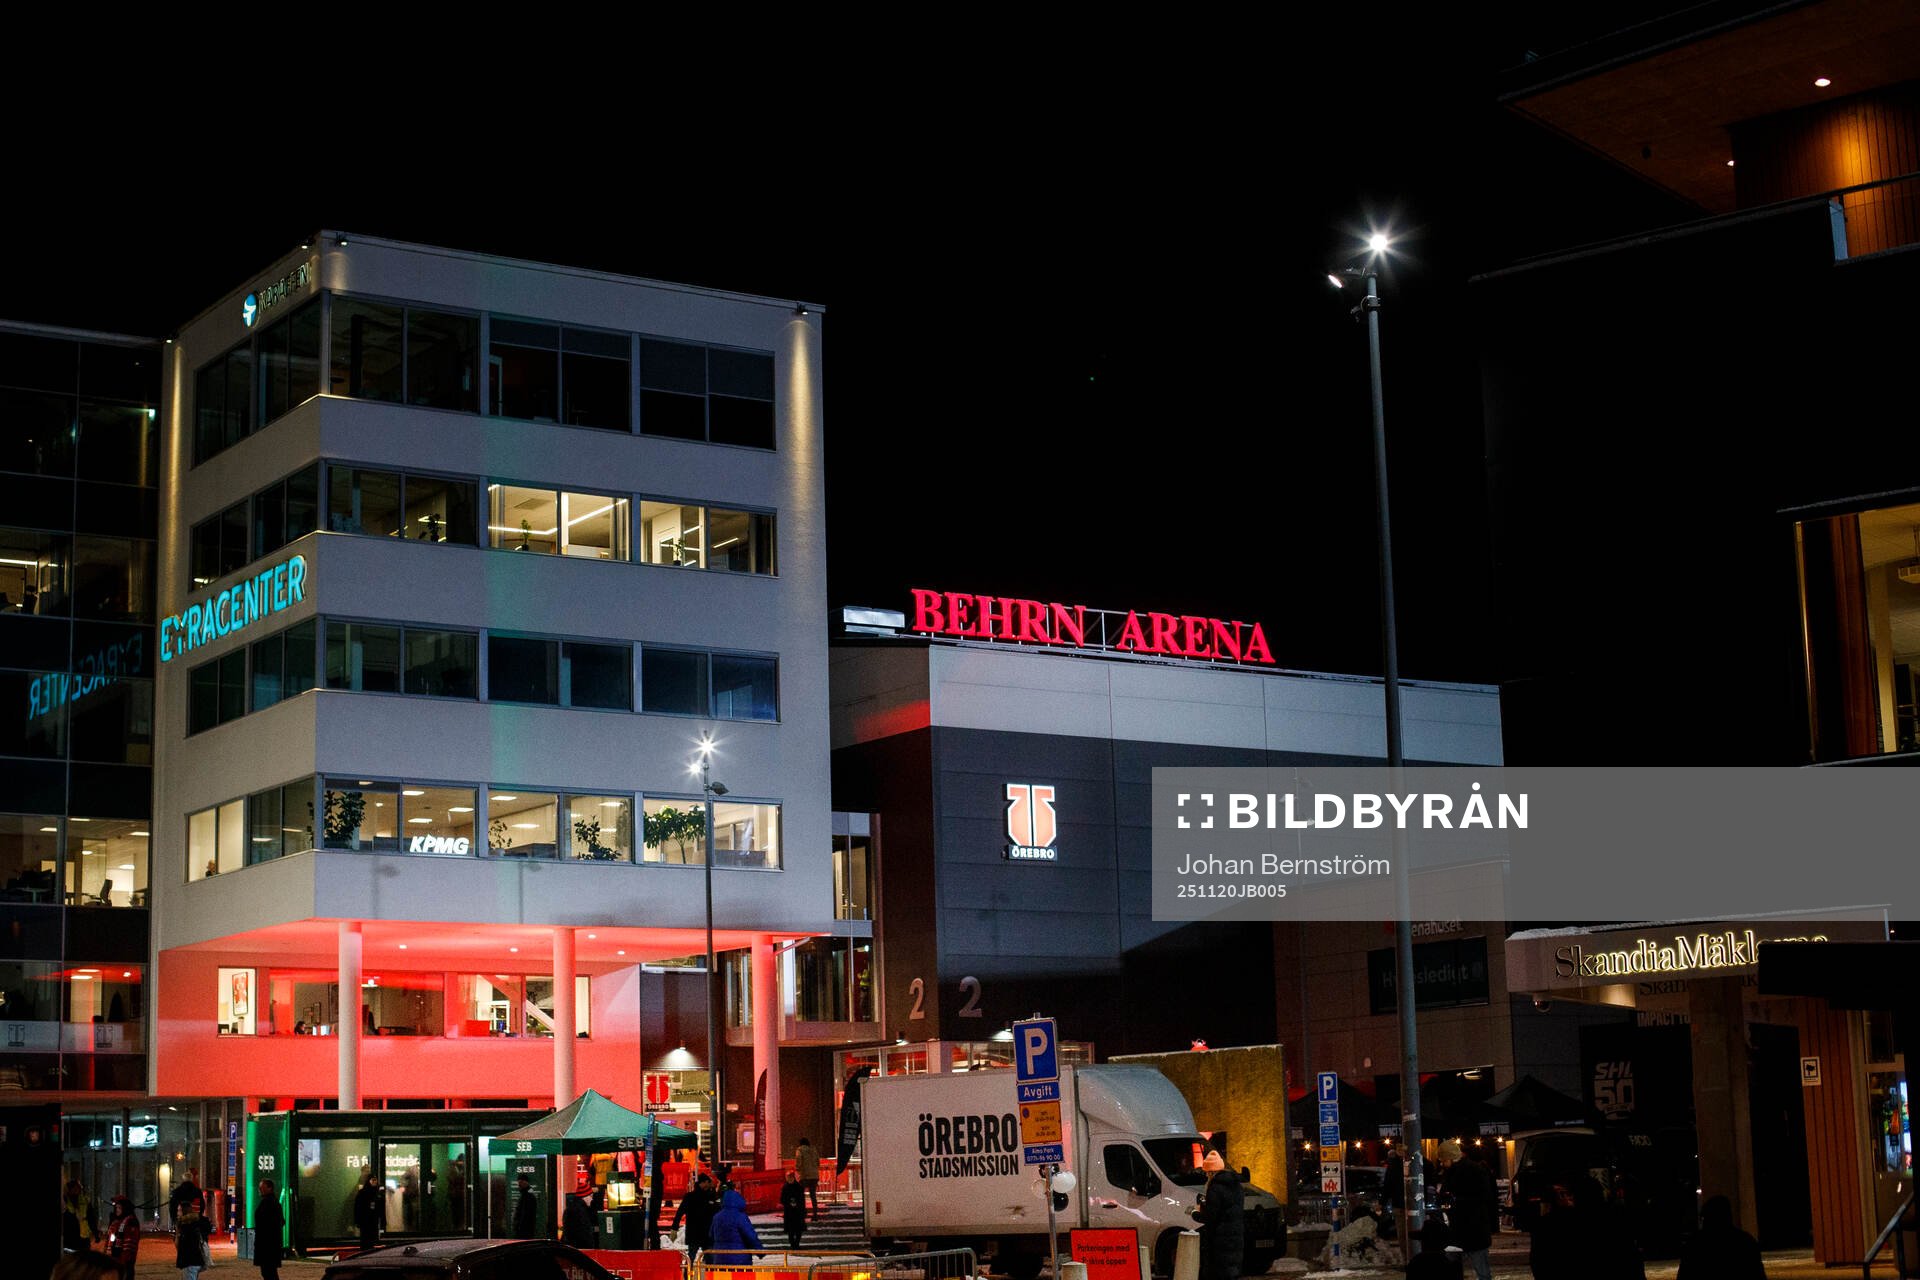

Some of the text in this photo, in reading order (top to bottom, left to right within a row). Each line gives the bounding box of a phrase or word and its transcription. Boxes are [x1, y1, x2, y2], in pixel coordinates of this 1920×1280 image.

[160, 555, 306, 662] EYRACENTER
[911, 588, 1276, 664] BEHRN ARENA
[410, 834, 470, 855] KPMG
[1012, 846, 1055, 859] ÖREBRO
[909, 977, 926, 1020] 2
[959, 975, 983, 1018] 2
[1024, 1028, 1048, 1075] P
[1593, 1060, 1633, 1080] SHL
[1024, 1085, 1053, 1099] Avgift
[1322, 1075, 1334, 1099] P
[1593, 1079, 1635, 1112] 50
[516, 1142, 533, 1152] SEB
[618, 1137, 645, 1149] SEB
[918, 1113, 1018, 1157] ÖREBRO
[258, 1153, 275, 1172] SEB
[346, 1155, 360, 1168] Få
[919, 1155, 1019, 1179] STADSMISSION
